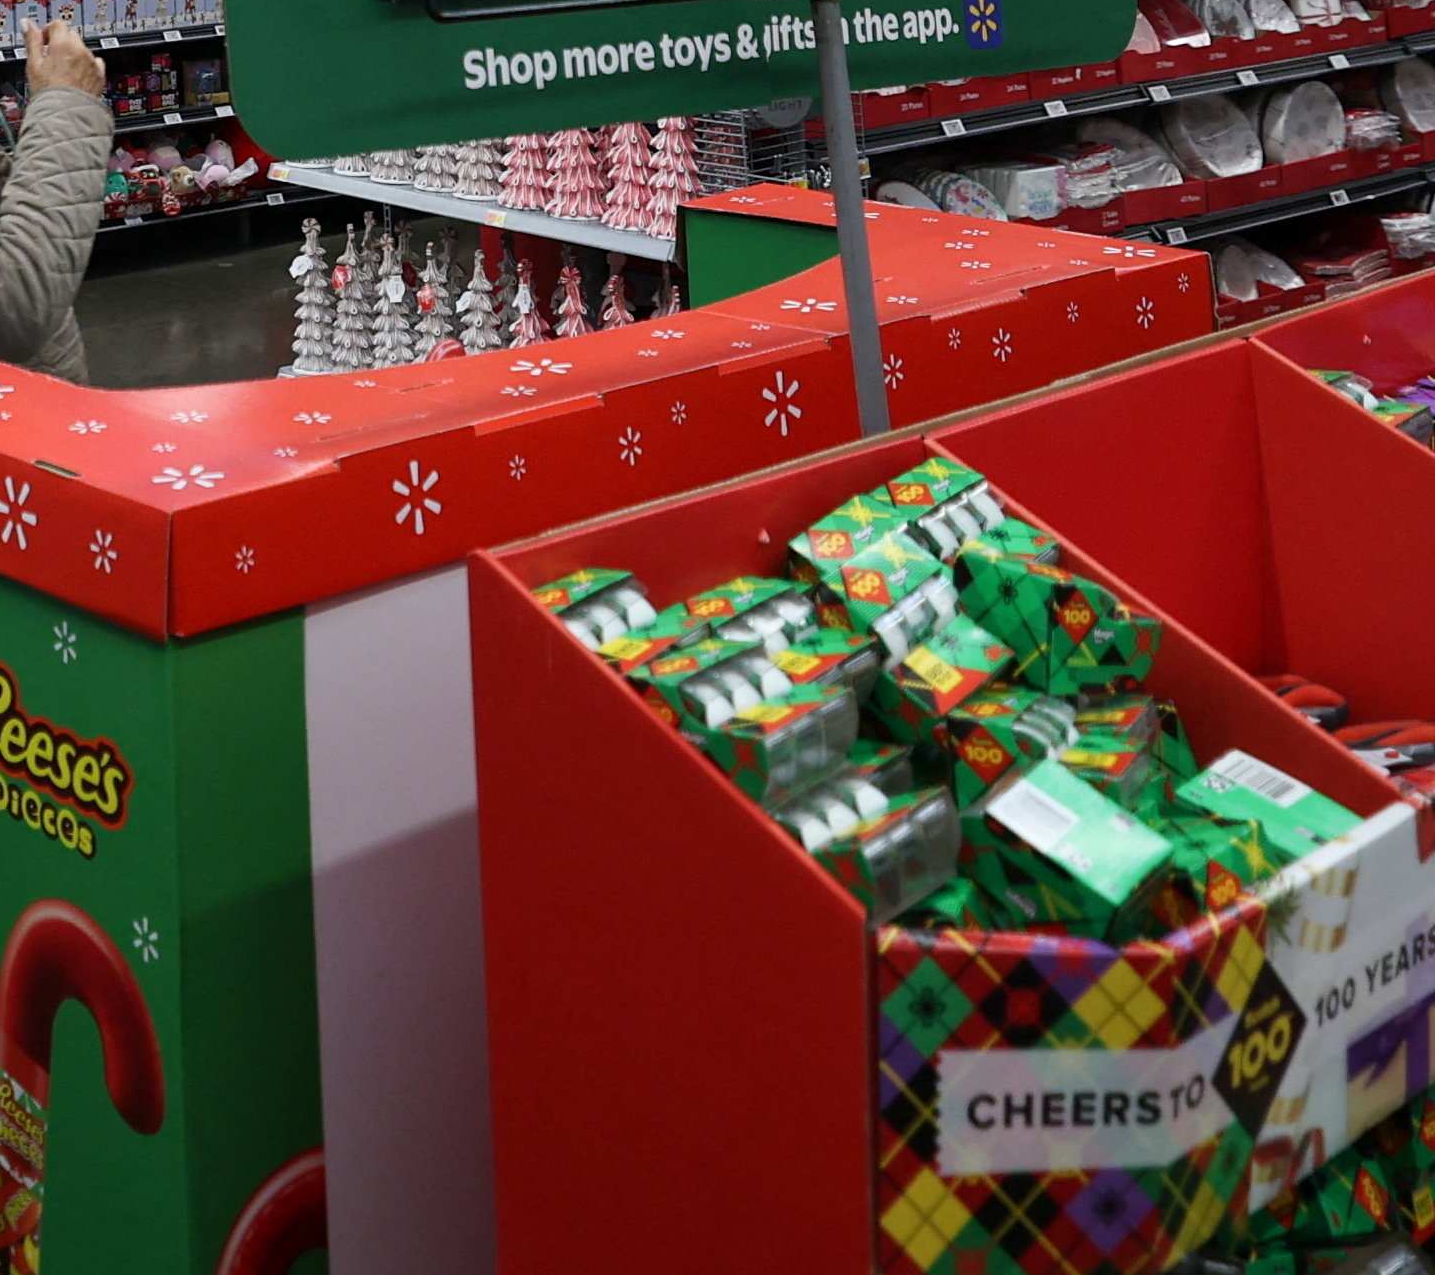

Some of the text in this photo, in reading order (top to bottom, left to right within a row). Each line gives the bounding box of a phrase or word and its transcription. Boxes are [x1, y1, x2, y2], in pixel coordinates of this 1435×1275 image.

[463, 48, 558, 90] Shop
[563, 37, 656, 79] more
[659, 30, 733, 72] toys
[735, 25, 761, 60] &
[852, 7, 900, 44] the
[902, 6, 960, 44] app.
[1314, 978, 1356, 1029] 100
[1227, 1011, 1294, 1089] 100
[967, 1074, 1207, 1131] CHEERS TO
